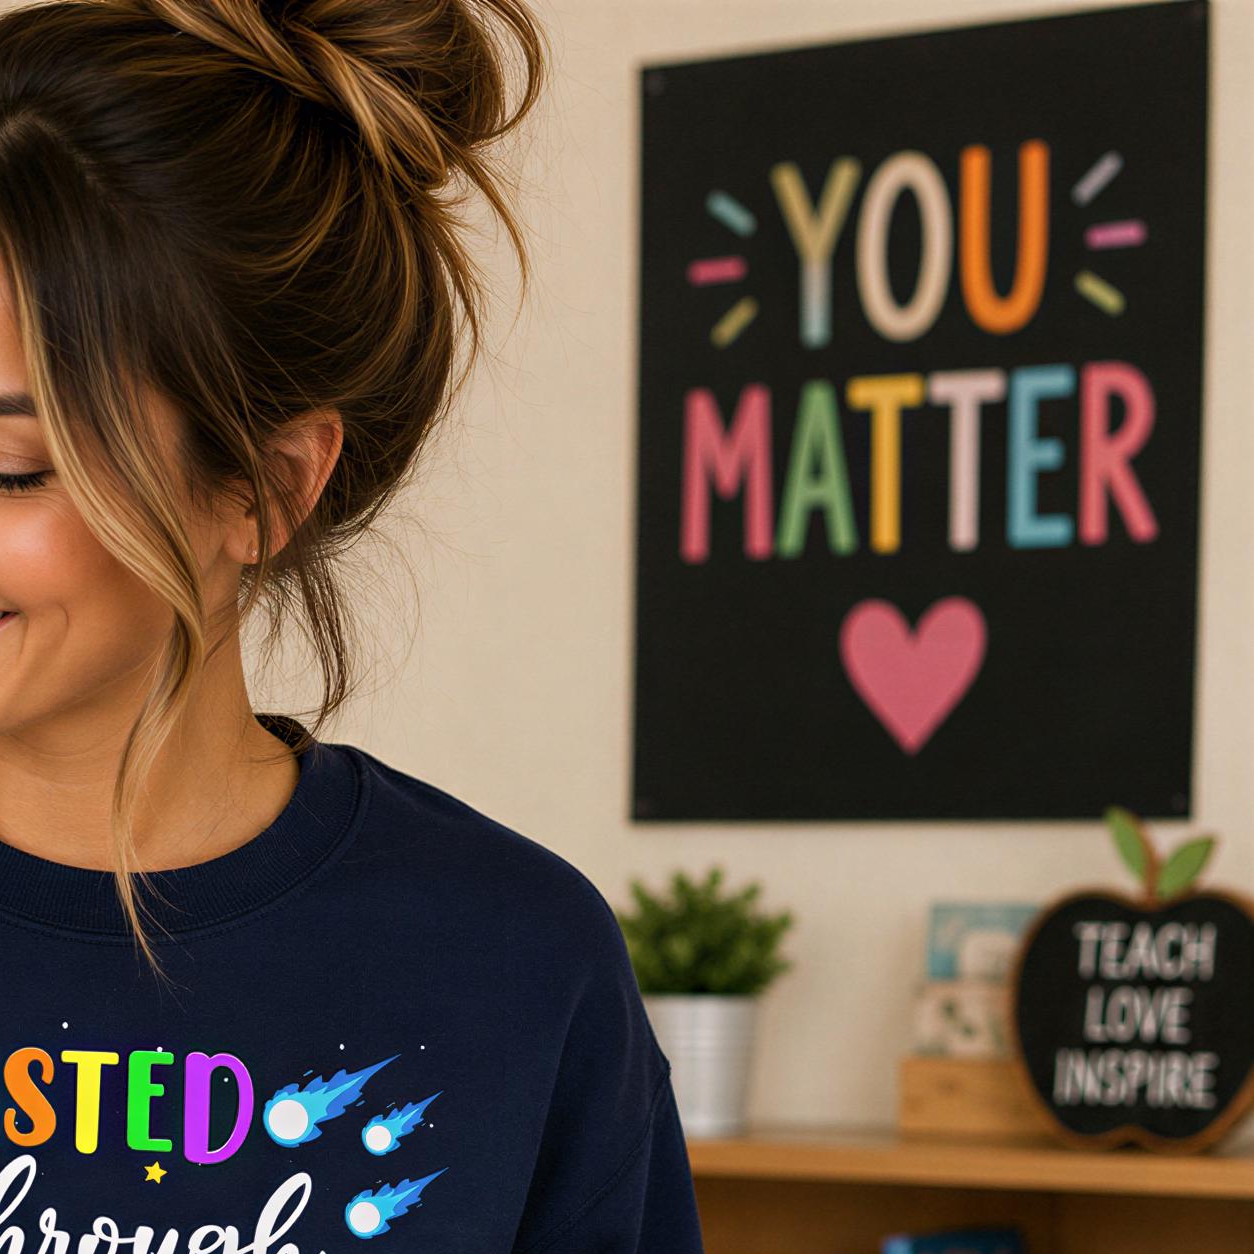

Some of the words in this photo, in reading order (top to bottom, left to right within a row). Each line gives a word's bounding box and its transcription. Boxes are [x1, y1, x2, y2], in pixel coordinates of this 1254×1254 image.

[770, 138, 1050, 349] YOU
[679, 360, 1159, 564] MATTER
[1073, 921, 1218, 981] TEACH
[1083, 985, 1195, 1044] LOVE
[1051, 1048, 1220, 1109] INSPIRE
